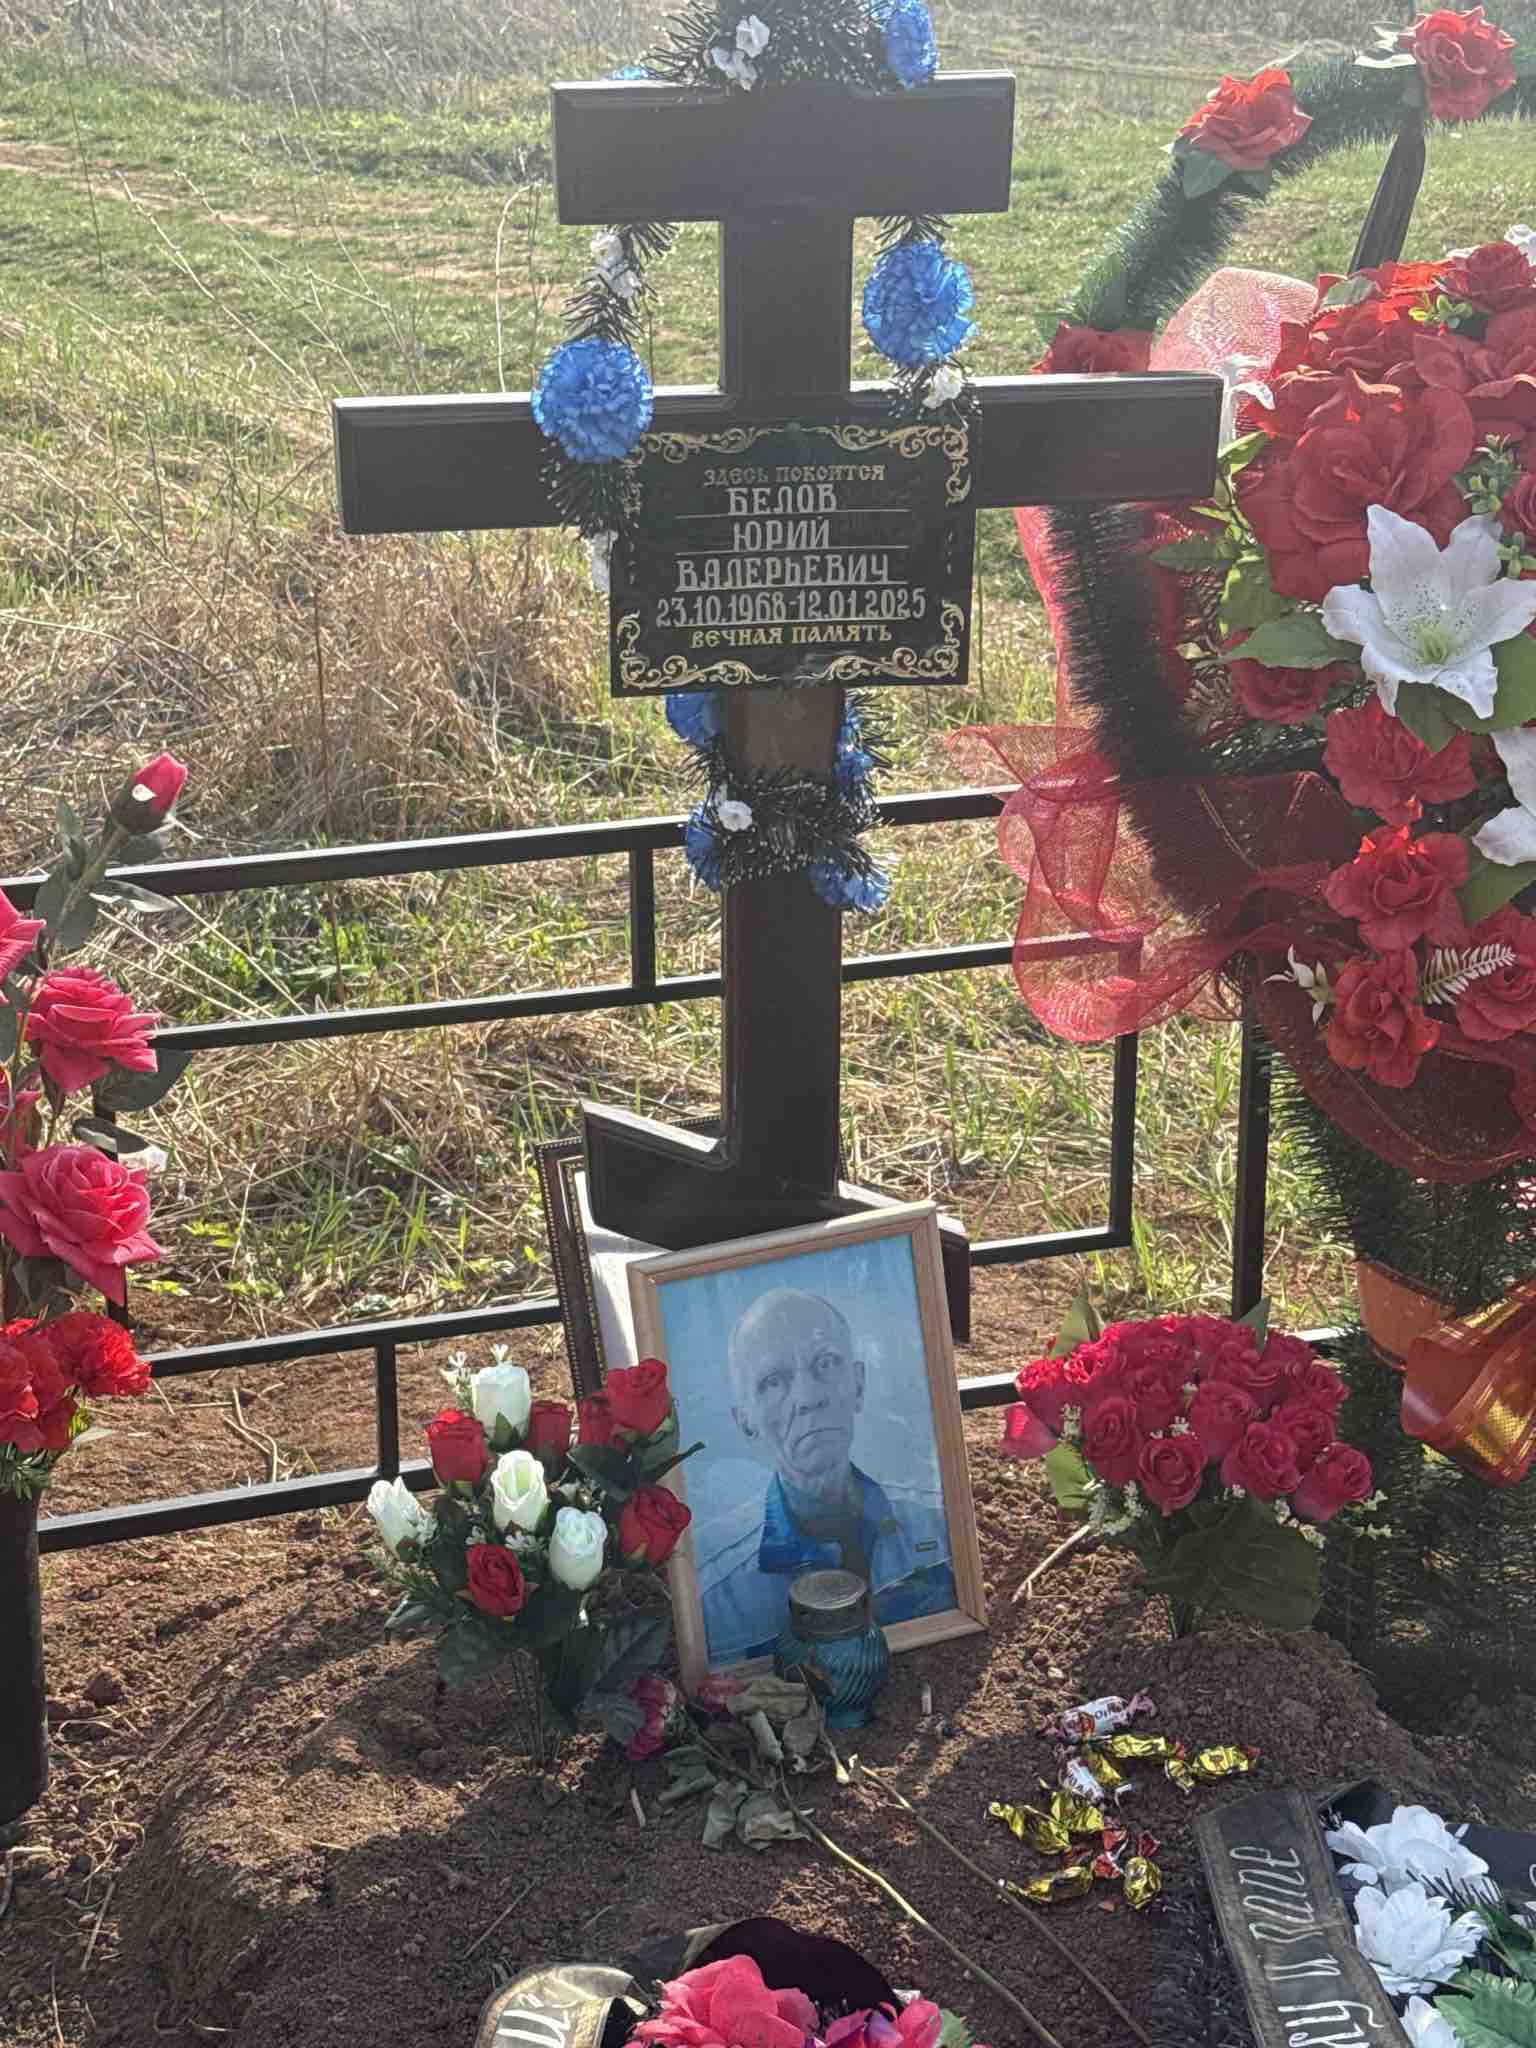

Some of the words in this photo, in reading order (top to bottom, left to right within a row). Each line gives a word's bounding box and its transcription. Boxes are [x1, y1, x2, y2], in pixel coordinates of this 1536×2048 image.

[726, 483, 838, 516] БЕЛОВ
[733, 515, 830, 552] ЮРИЙ
[676, 554, 889, 592] ВАЛЕРЬЕВИЧ
